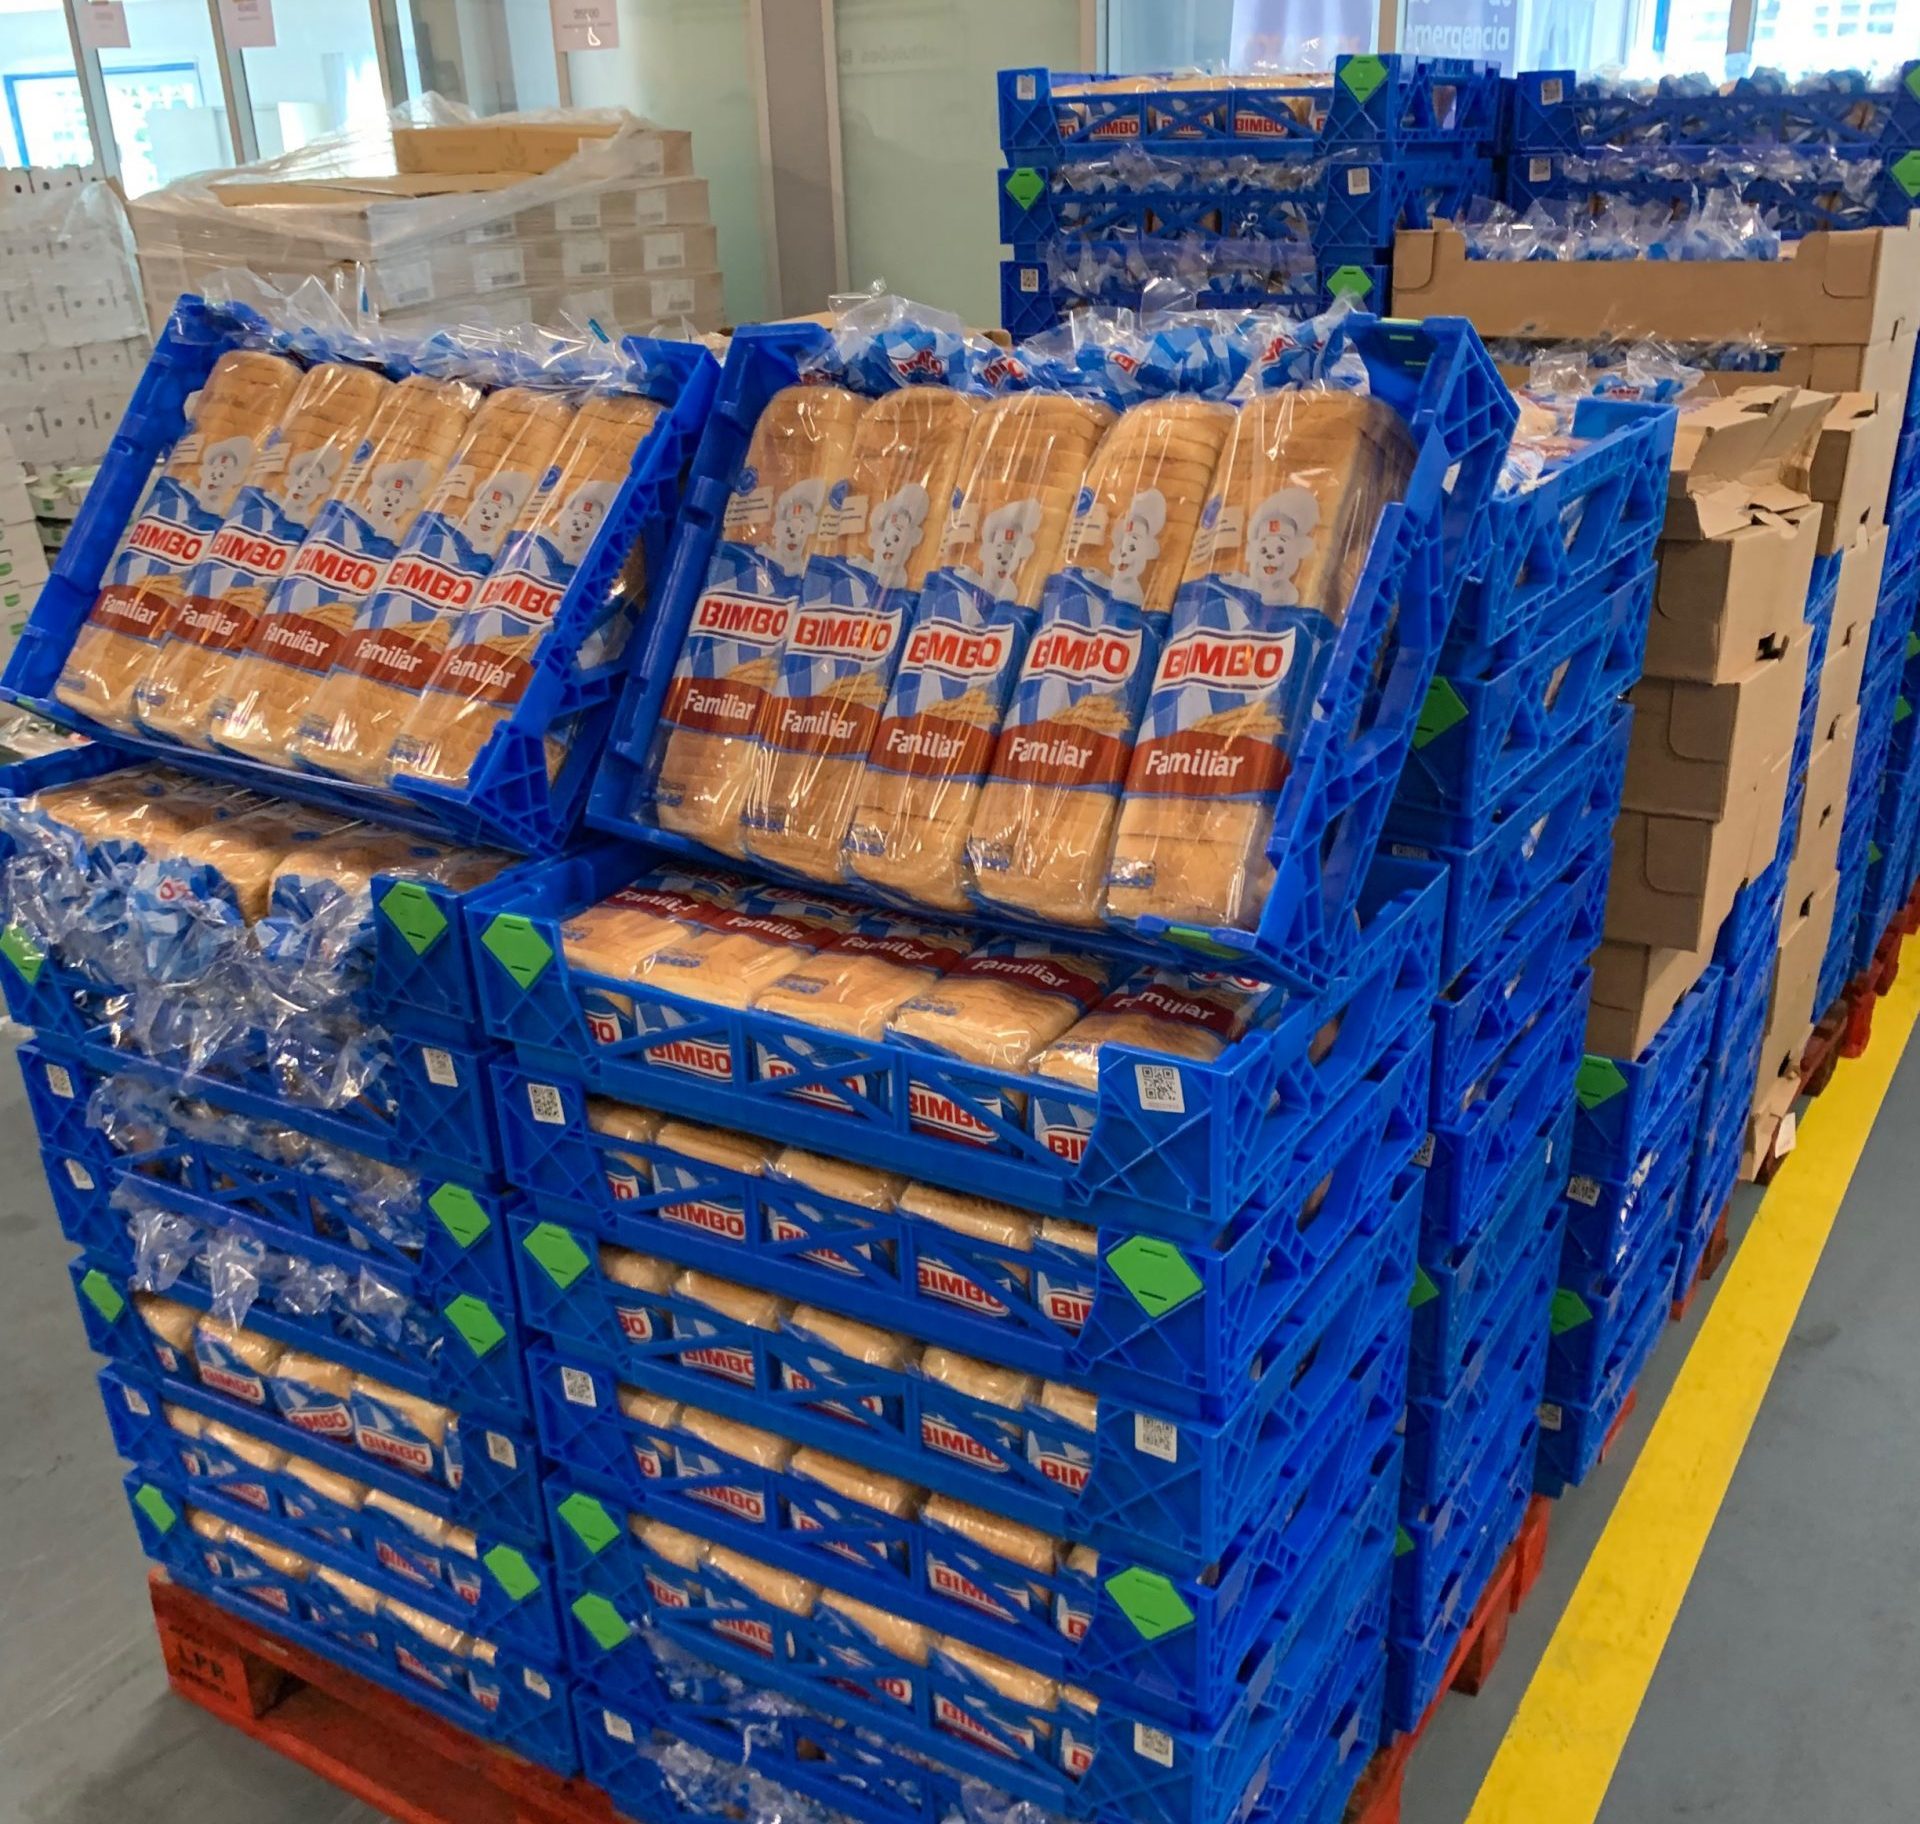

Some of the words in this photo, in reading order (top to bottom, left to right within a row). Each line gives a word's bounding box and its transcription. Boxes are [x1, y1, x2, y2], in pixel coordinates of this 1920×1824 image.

[129, 523, 203, 560] BIMBO
[210, 532, 287, 571] BIMBO
[386, 561, 474, 605] BMBO
[480, 579, 563, 618] BMBO
[101, 591, 158, 625] Familiar
[178, 603, 239, 636] Familiar
[699, 599, 788, 637] BIMBO
[263, 622, 328, 657] Familiar
[355, 638, 422, 673] Familiar
[907, 631, 1002, 668] BMBO
[1030, 634, 1130, 675] BMBO
[443, 653, 516, 689] Familiar
[683, 689, 755, 721] Familiar
[781, 708, 857, 740] Familiar
[1007, 736, 1093, 770] Familiar
[1145, 749, 1244, 778] Familiar
[726, 916, 804, 940] Familia
[975, 959, 1070, 988] Familiar
[1114, 991, 1215, 1020] Fmiliar
[362, 1432, 427, 1466] BIMBO
[697, 1486, 761, 1516] IMBO
